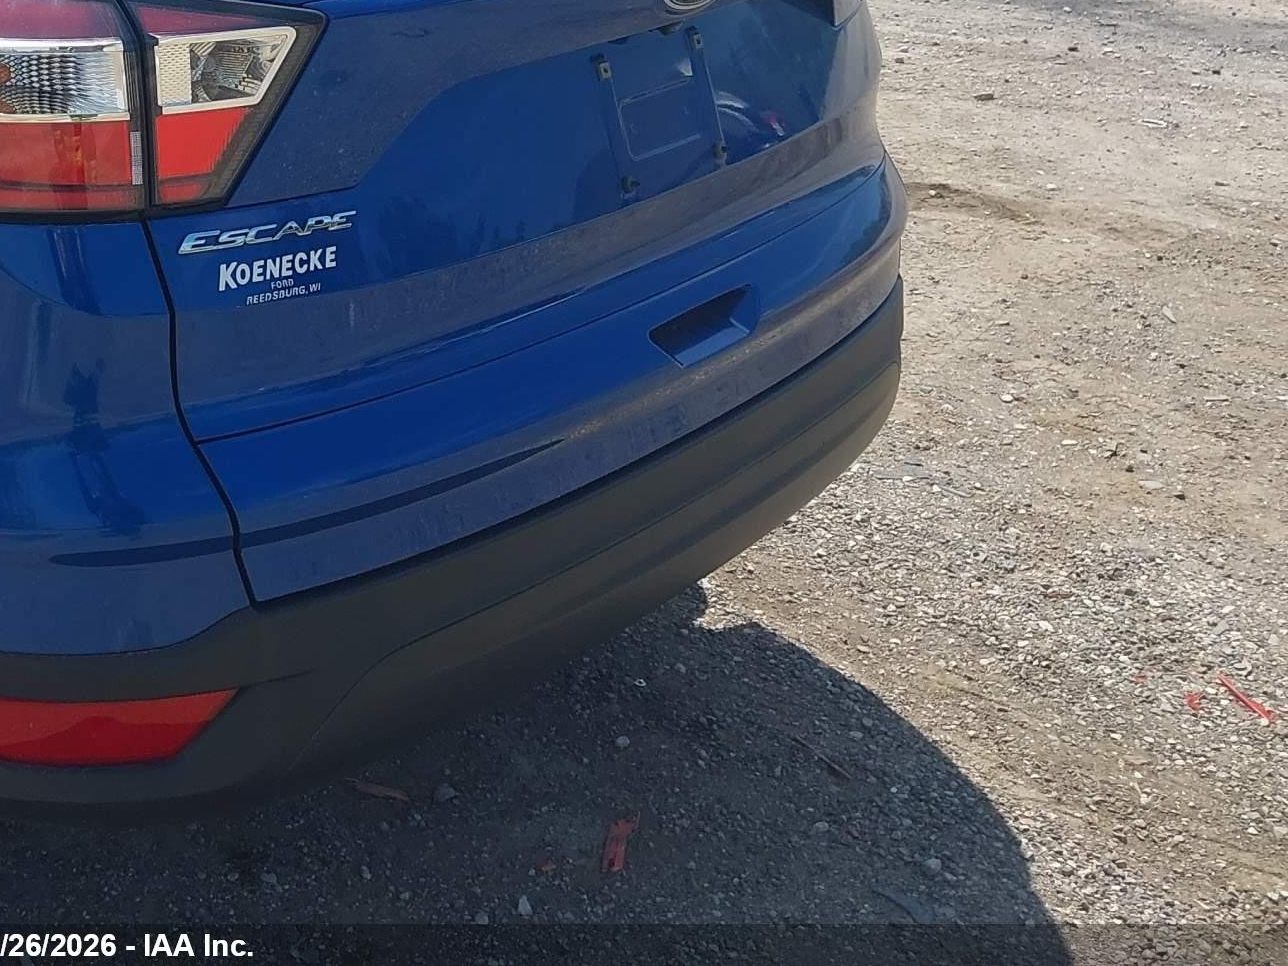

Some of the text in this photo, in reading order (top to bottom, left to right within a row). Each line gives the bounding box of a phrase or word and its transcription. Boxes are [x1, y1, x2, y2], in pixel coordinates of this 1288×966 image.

[178, 210, 357, 255] ESCAPE
[218, 246, 337, 291] KOENECKE
[270, 278, 294, 290] FORD
